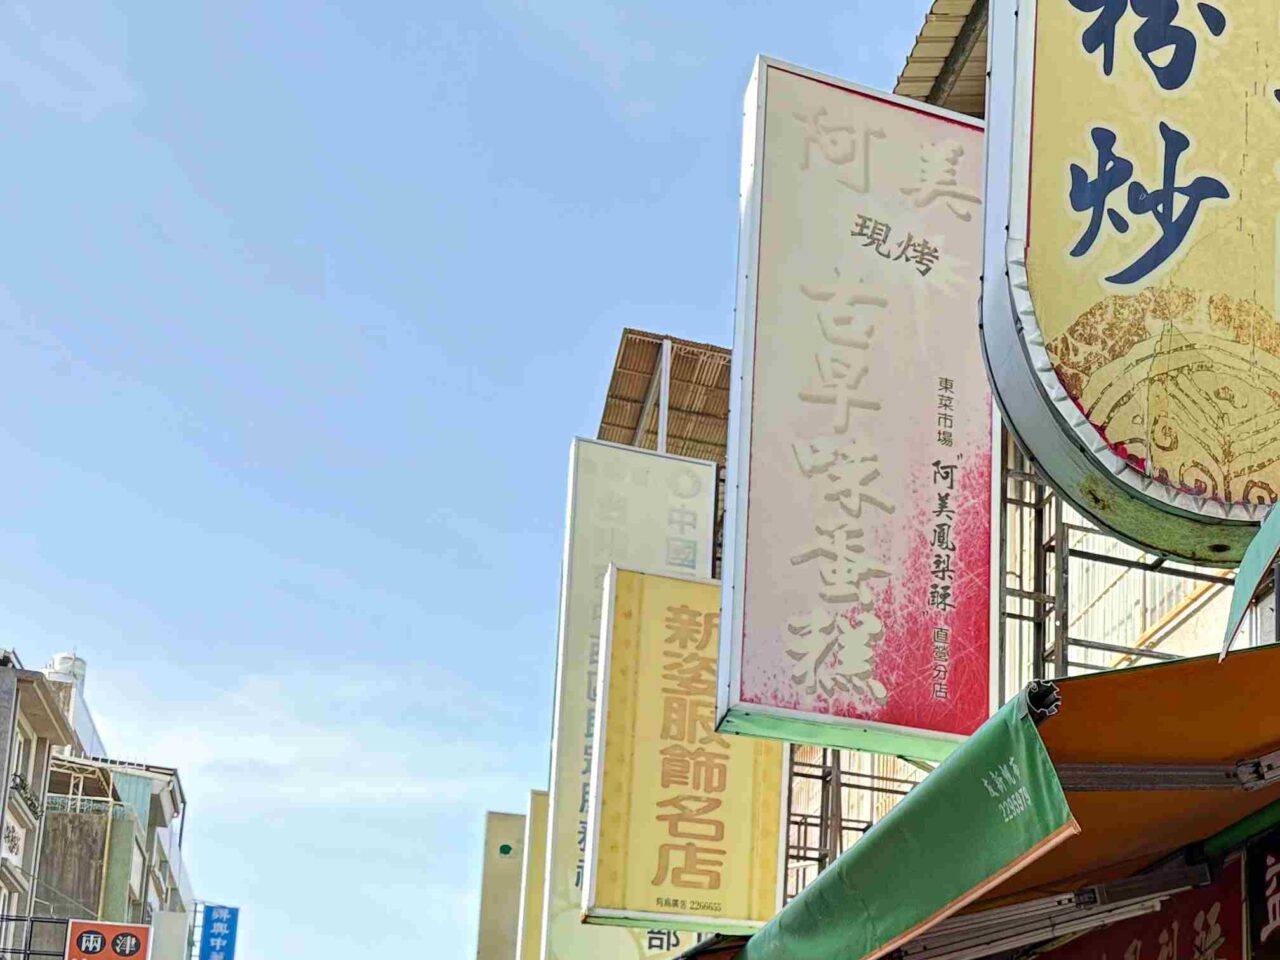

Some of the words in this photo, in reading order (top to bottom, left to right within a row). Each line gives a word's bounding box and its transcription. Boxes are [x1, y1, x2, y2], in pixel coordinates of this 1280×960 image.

[850, 214, 940, 276] 現烤
[936, 377, 955, 448] 東菜市場
[930, 627, 949, 701] 直營分店
